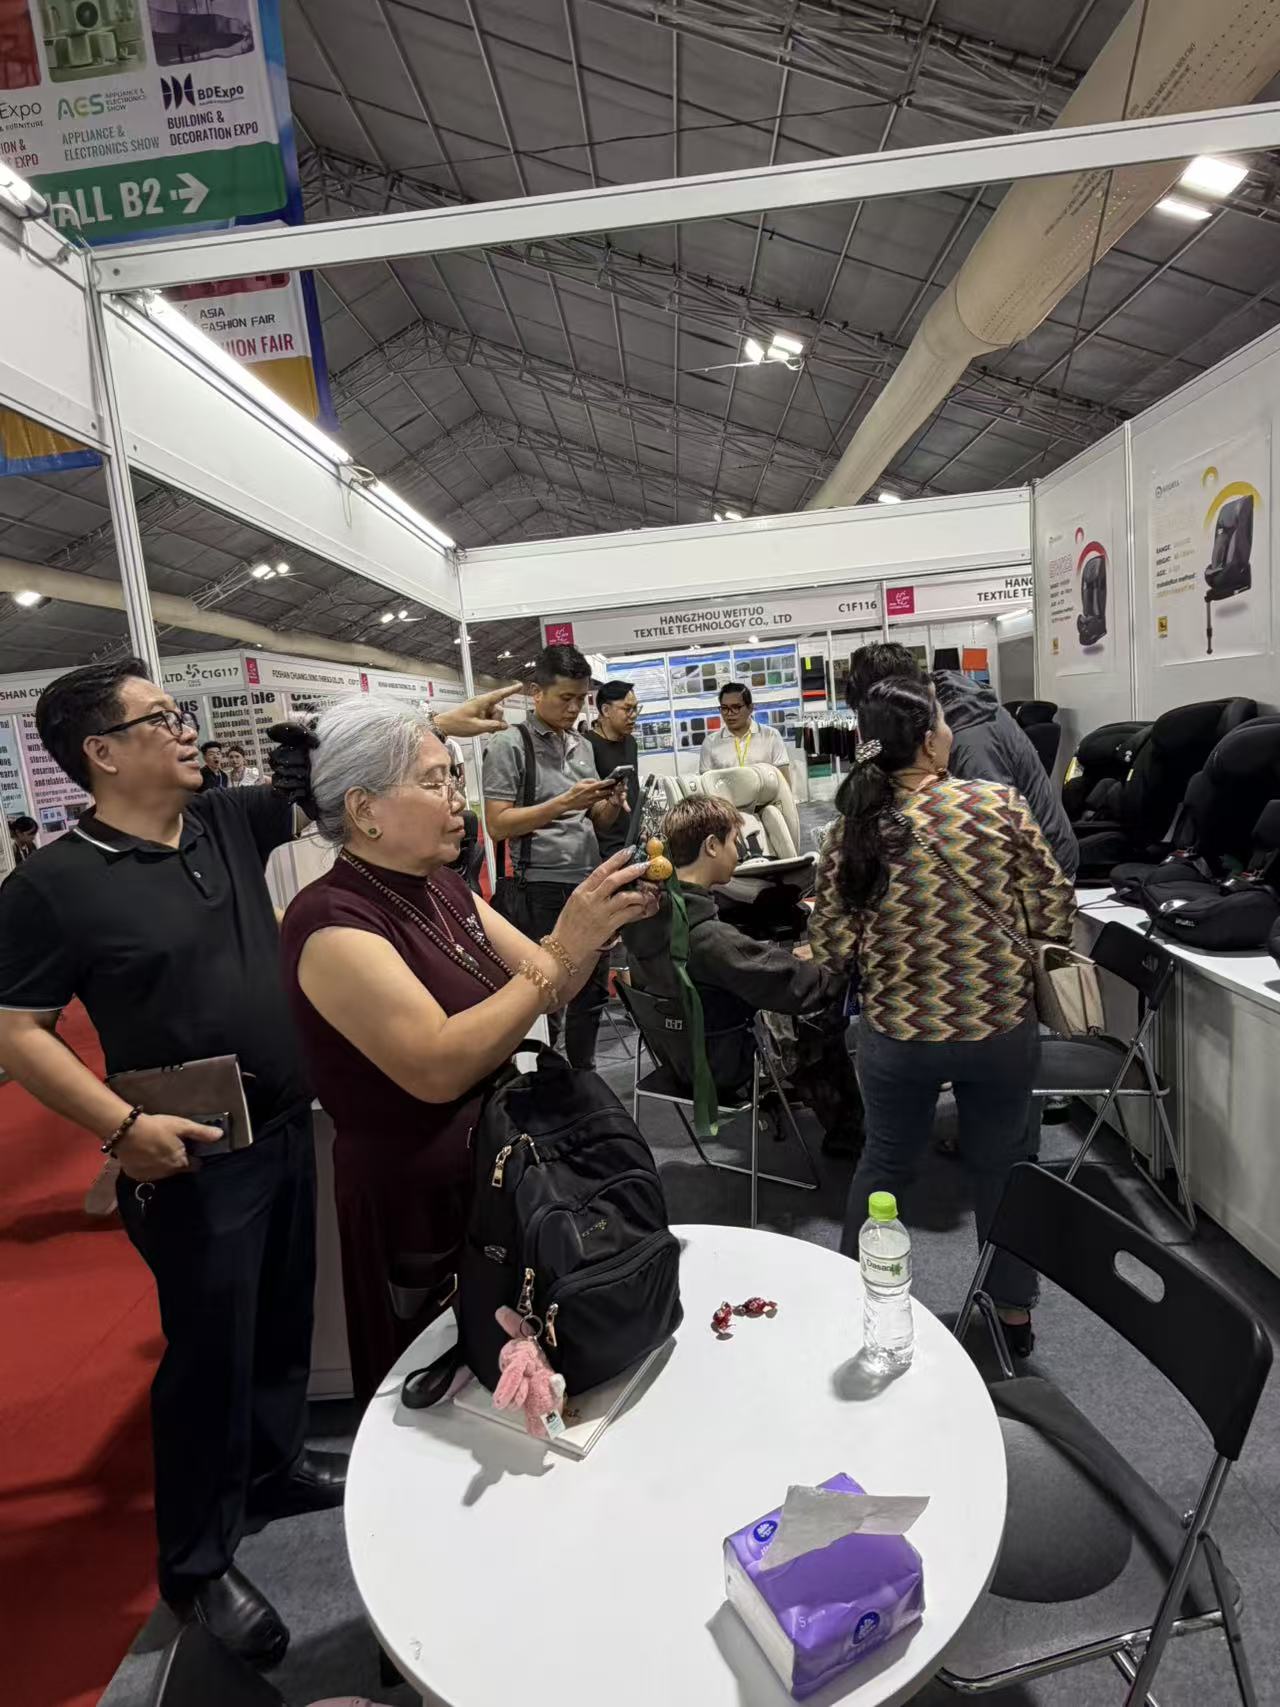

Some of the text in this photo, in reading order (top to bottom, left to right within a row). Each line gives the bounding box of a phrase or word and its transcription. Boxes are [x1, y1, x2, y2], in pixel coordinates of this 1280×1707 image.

[198, 85, 244, 101] BDExpo
[0, 102, 42, 120] Expo
[167, 110, 225, 129] BUILDING &
[62, 125, 126, 145] APPLIANCE &
[170, 121, 259, 146] DECORATION EXPO
[19, 138, 26, 151] &
[64, 136, 160, 161] ELECTRONICS SHOW
[15, 153, 39, 169] EXPO
[120, 178, 164, 218] B2
[200, 307, 225, 319] ASIA
[201, 313, 275, 332] FASHION FAIR
[261, 333, 294, 354] FAIR
[977, 589, 1019, 602] TEXTILE
[660, 606, 764, 626] HANGZHOU WEITUO
[838, 600, 877, 613] C1F116
[634, 624, 674, 638] TEXTILE
[676, 618, 746, 635] TECHNOLOGY
[773, 613, 792, 625] LTD
[202, 667, 239, 680] C1G117
